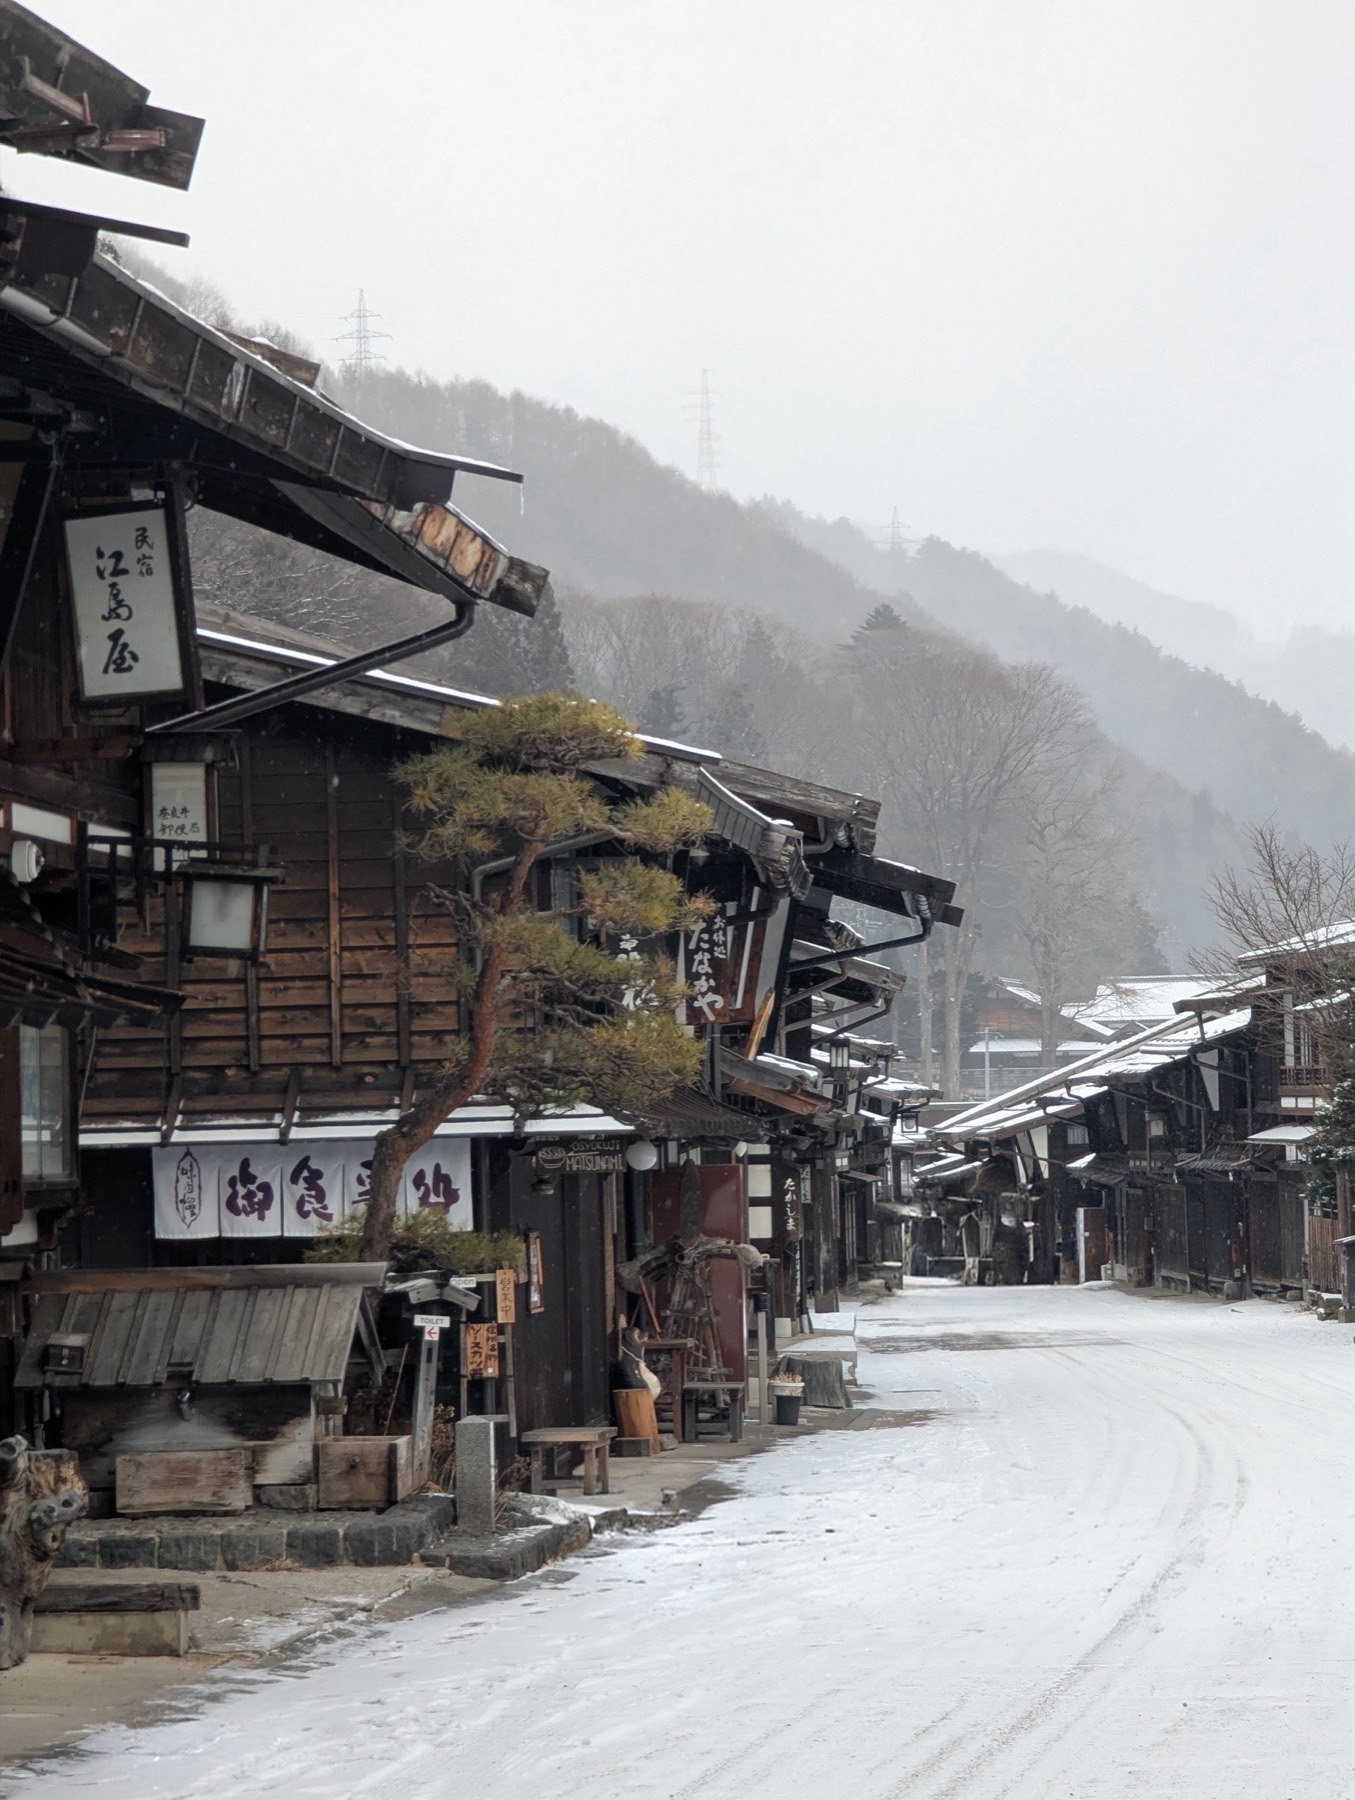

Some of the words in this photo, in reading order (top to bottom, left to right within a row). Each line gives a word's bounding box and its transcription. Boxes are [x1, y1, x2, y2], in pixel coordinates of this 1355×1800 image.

[135, 526, 154, 577] 民宿
[96, 547, 139, 675] 江島屋
[158, 806, 190, 821] 奈良井
[159, 822, 200, 837] 郵便局
[713, 915, 727, 959] お休処
[688, 919, 724, 1021] たなかや
[566, 1153, 624, 1171] MATSUNAMI
[784, 1177, 796, 1230] たかしま
[420, 1317, 444, 1325] TOILET
